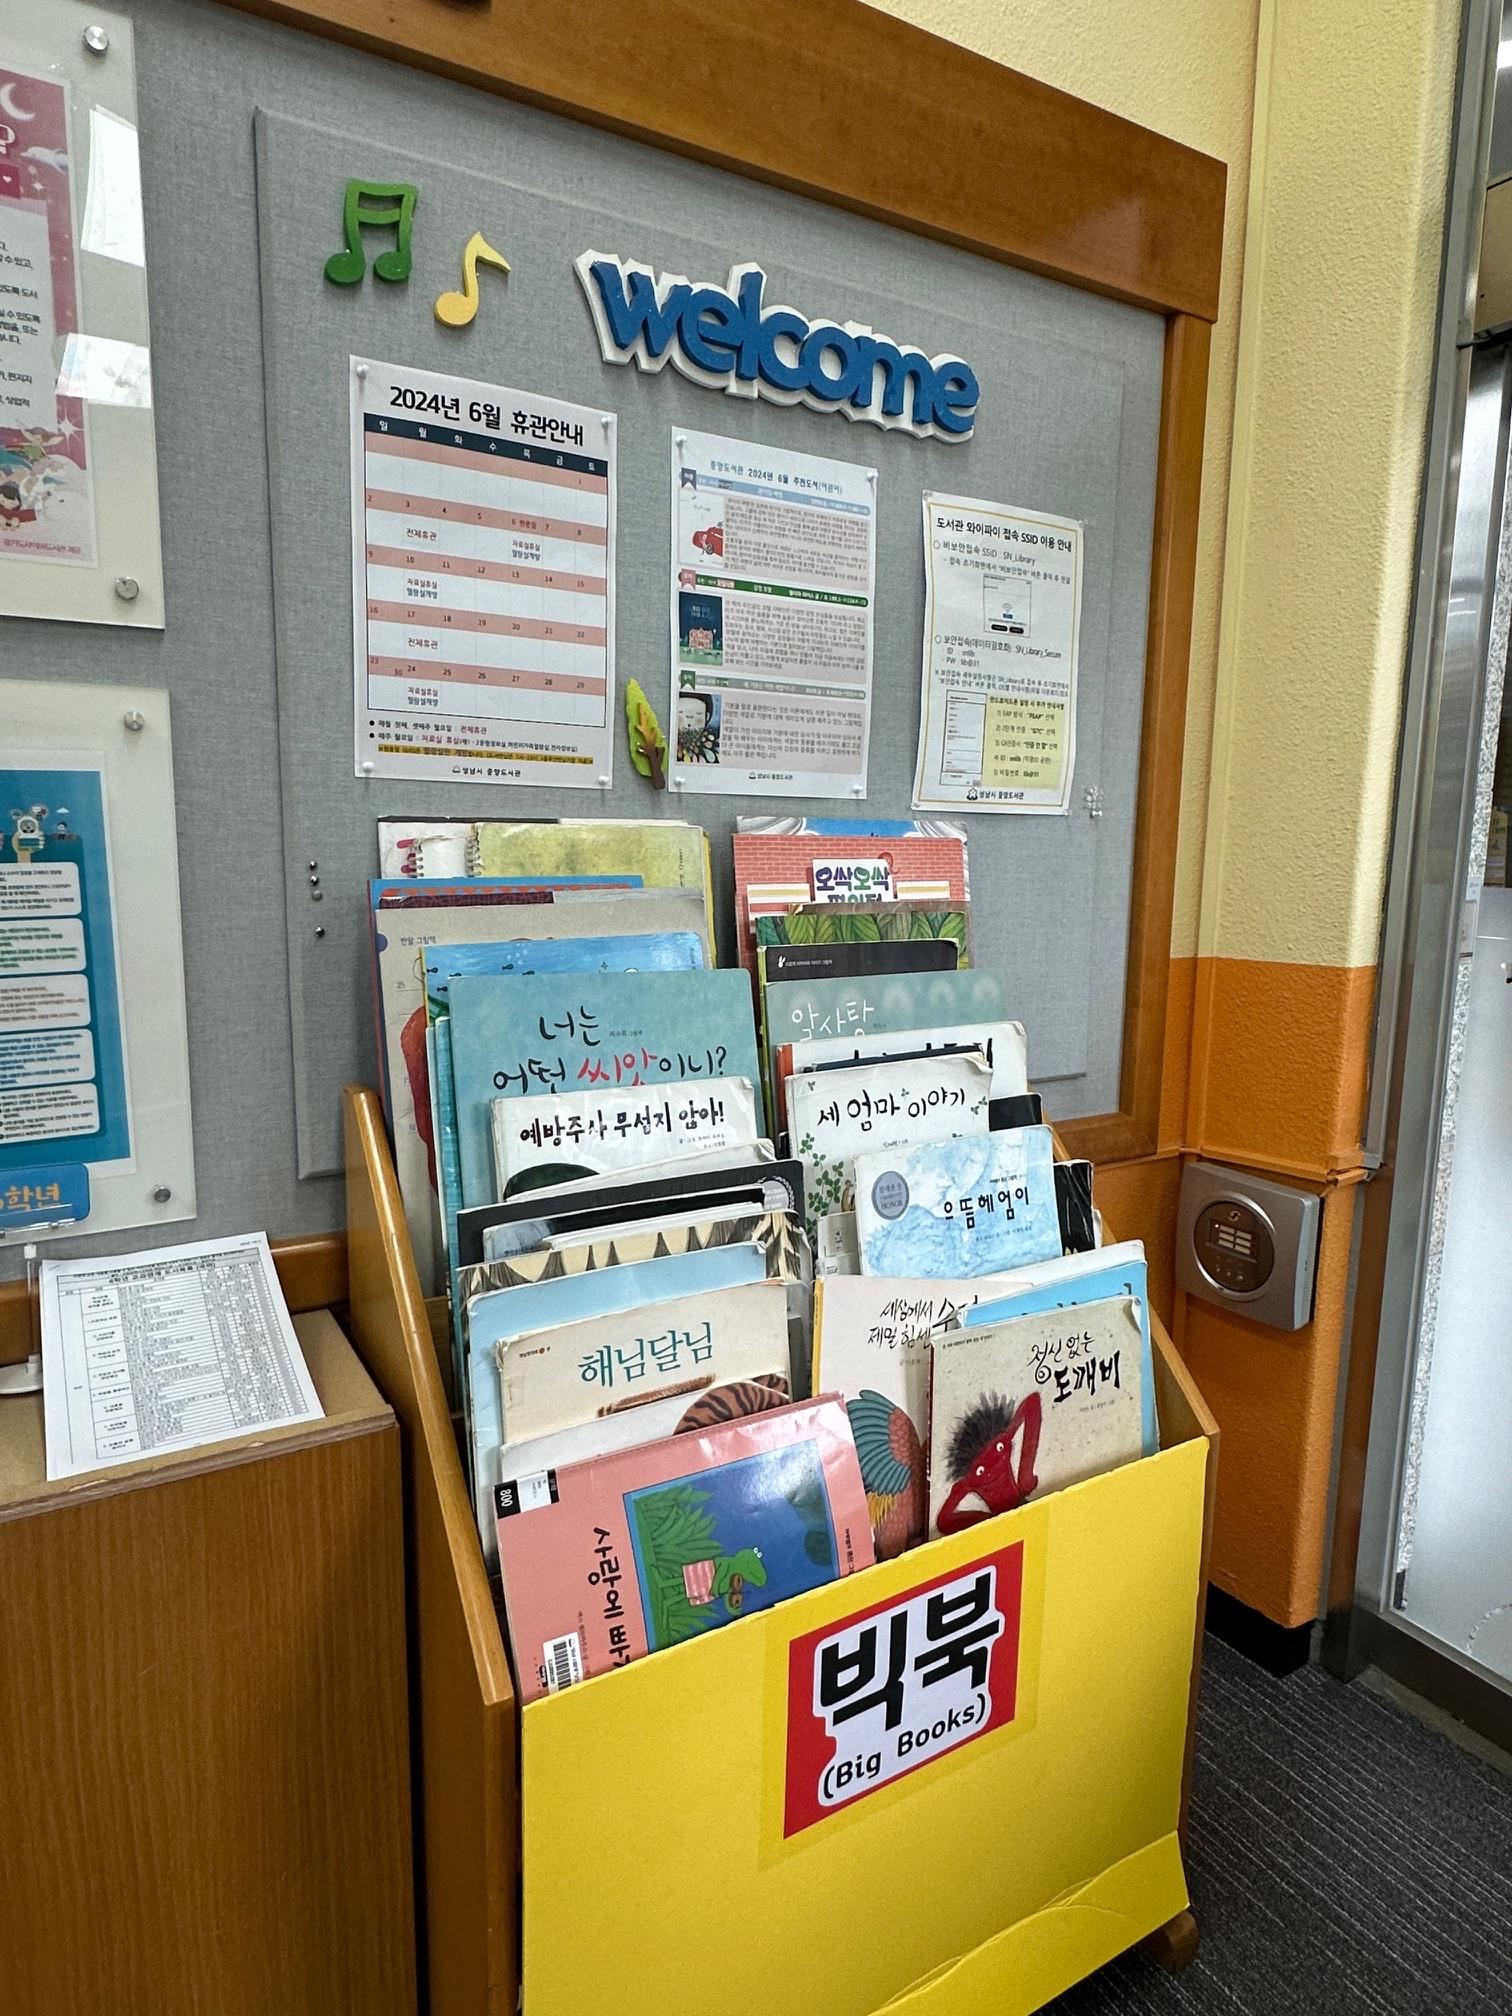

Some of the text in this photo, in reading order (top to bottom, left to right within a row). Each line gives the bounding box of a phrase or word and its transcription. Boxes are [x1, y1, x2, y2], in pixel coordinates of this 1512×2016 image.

[590, 261, 980, 434] welcome
[390, 386, 584, 446] 2024년 6월 휴관안내
[379, 420, 388, 431] 일
[418, 427, 427, 439] 월
[454, 434, 463, 445] 화
[489, 442, 497, 451] 수
[556, 456, 564, 465] 금
[748, 468, 774, 482] 2024년
[777, 474, 789, 484] 6월
[936, 517, 1072, 552] 도서관 와이파이 접속 SSID 이용 안내
[942, 541, 980, 555] 비보안접속
[982, 547, 998, 558] SSID
[406, 556, 415, 564] 10
[442, 561, 451, 569] 11
[511, 571, 520, 579] 13
[544, 575, 553, 583] 14
[407, 665, 416, 673] 24
[815, 866, 890, 891] 오싹오싹
[538, 1005, 602, 1047] 너는
[792, 1000, 875, 1042] 알사탕
[493, 1056, 567, 1095] 어떤
[519, 1109, 608, 1148] 예방주사
[678, 1097, 725, 1130] 않아!
[817, 1086, 966, 1132] 세 엄마 이야기
[0, 1183, 60, 1211] 학년
[943, 1186, 1030, 1230] 으뜸헤엄이
[880, 1298, 933, 1323] 세상에서
[577, 1320, 714, 1388] 해님달님
[868, 1326, 899, 1350] 제일
[1027, 1338, 1063, 1385] 정신
[1066, 1331, 1096, 1359] 없는
[1053, 1349, 1121, 1403] 도깨비
[500, 1489, 513, 1507] 800
[588, 1527, 625, 1618] 사랑에
[820, 1572, 1000, 1732] 빅북
[823, 1692, 987, 1799] (Big Books)
